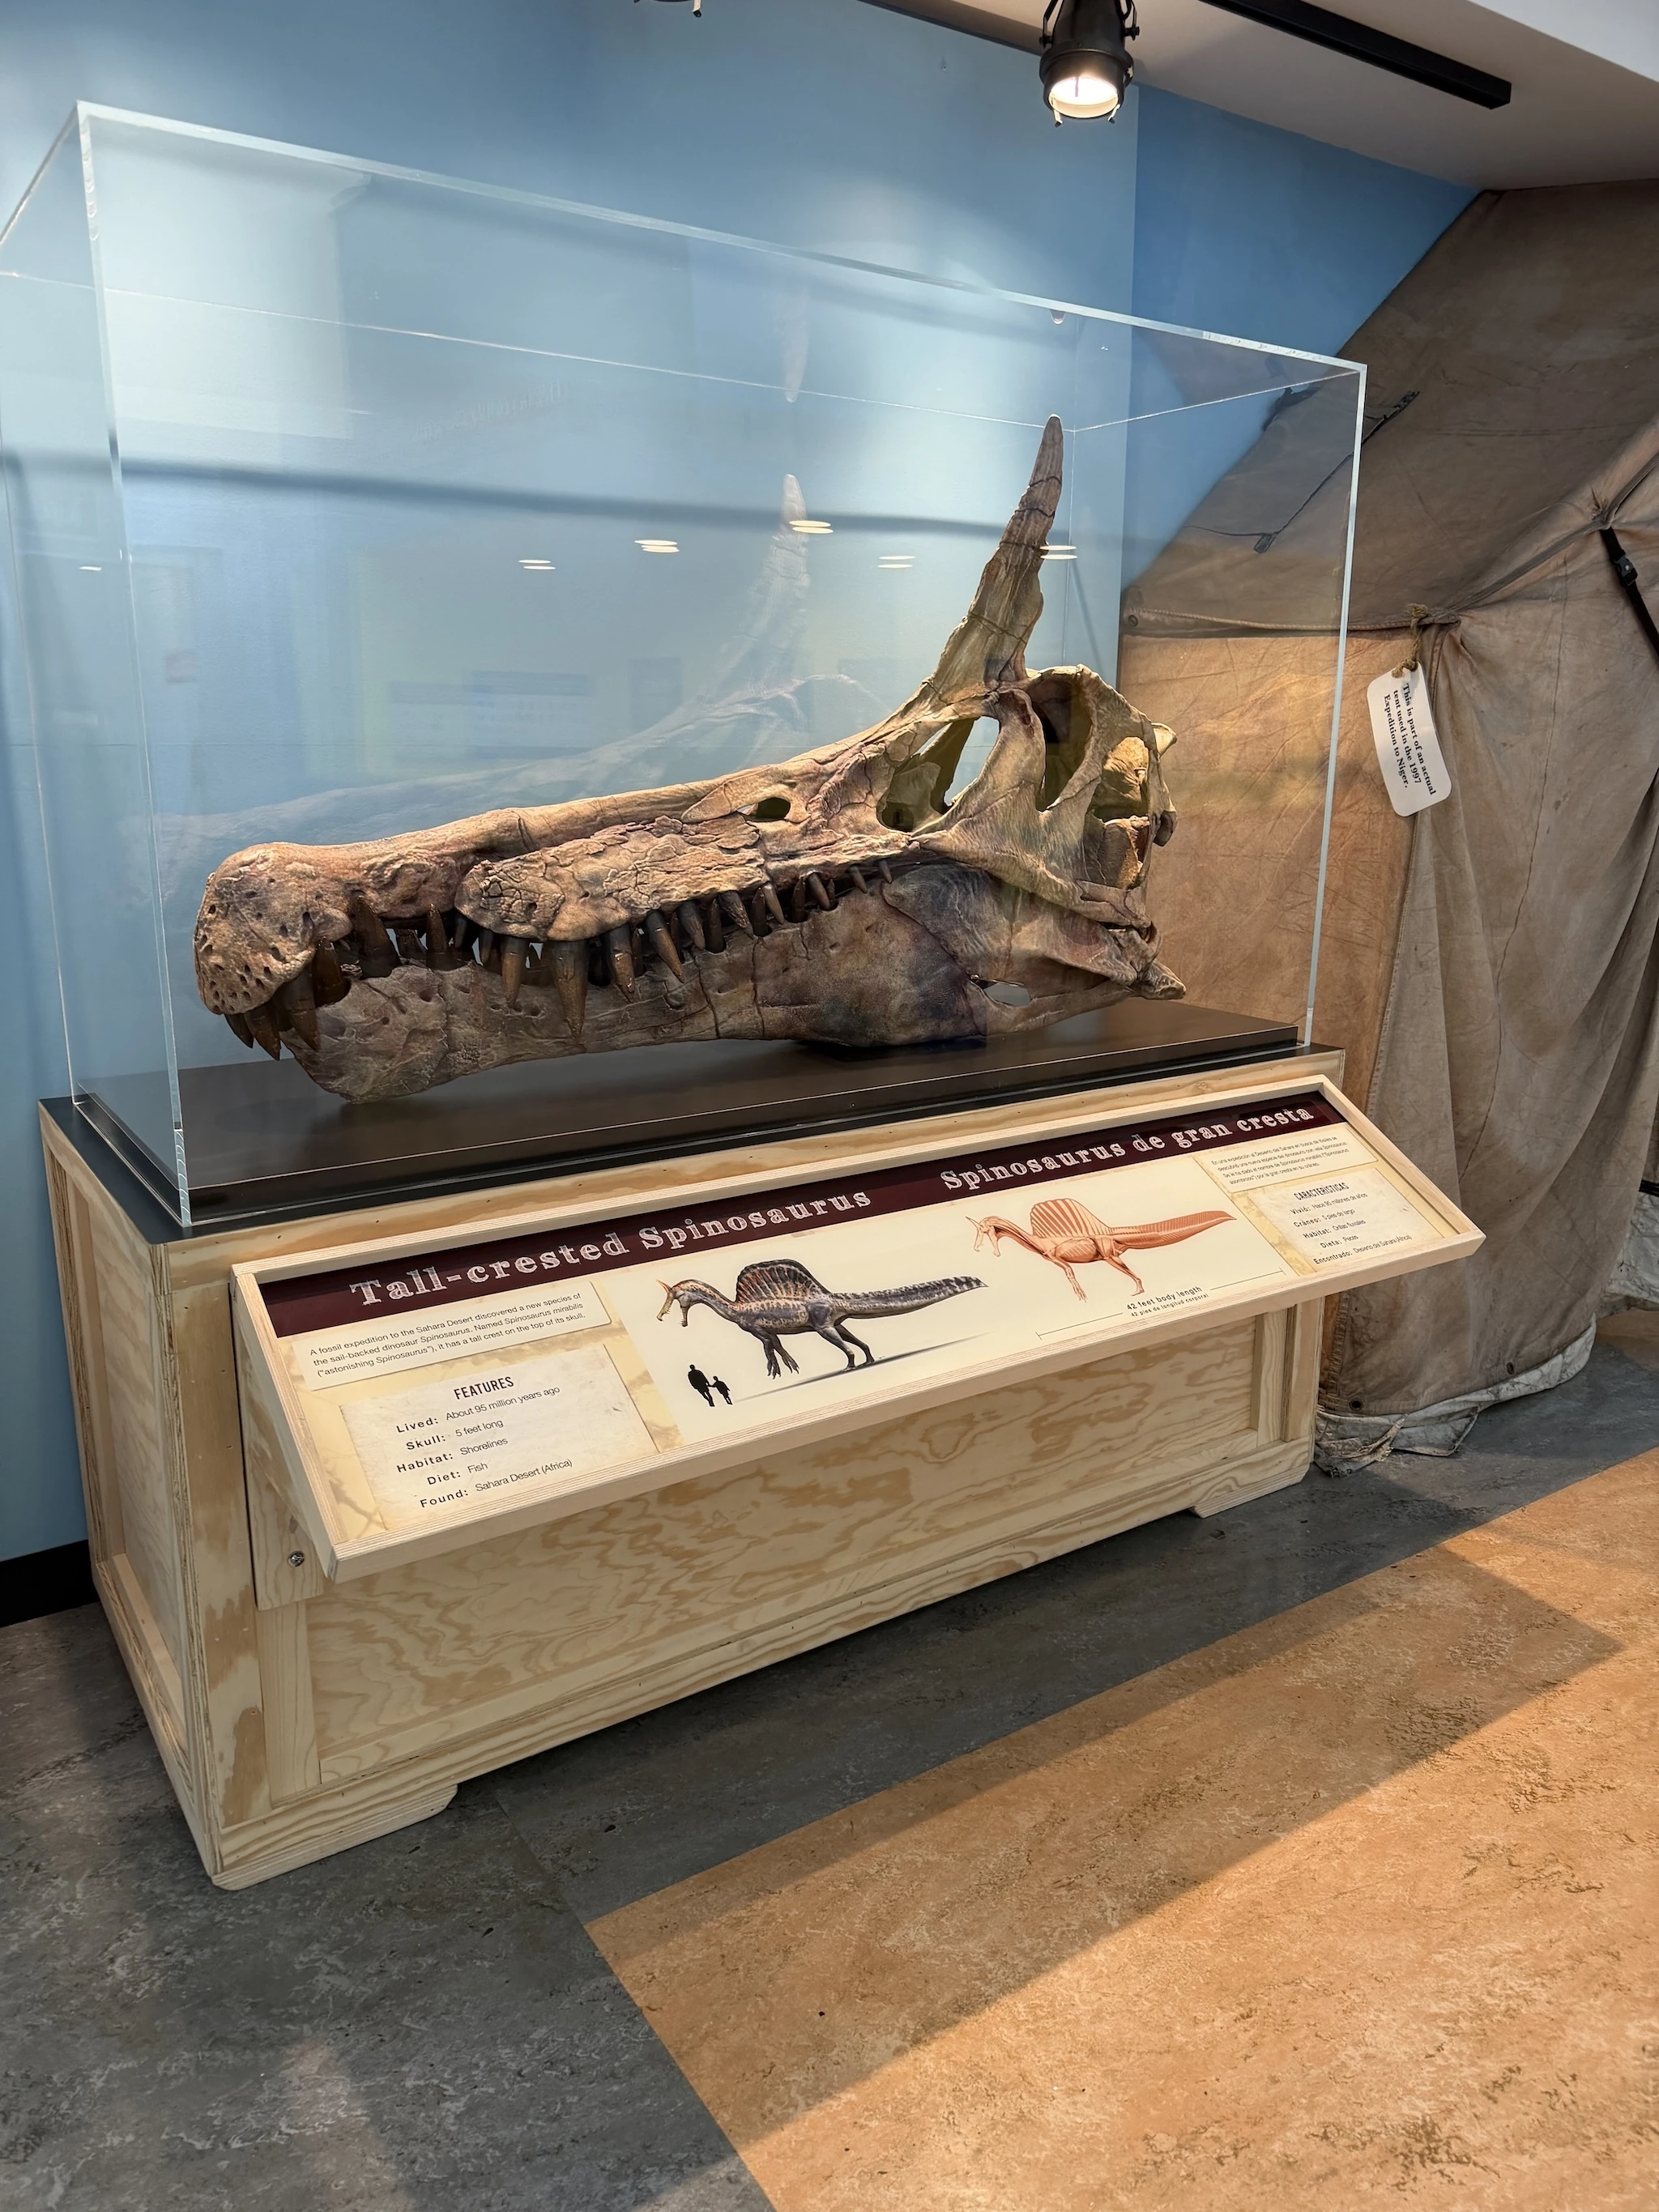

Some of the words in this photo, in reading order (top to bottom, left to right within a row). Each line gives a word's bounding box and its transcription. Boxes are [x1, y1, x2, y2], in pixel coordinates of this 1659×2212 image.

[1393, 690, 1401, 709] tent
[1402, 683, 1411, 706] This
[1397, 710, 1406, 732] used
[1406, 707, 1413, 716] is
[1401, 734, 1407, 744] in
[1408, 717, 1418, 739] part
[1384, 694, 1397, 745] Expedition
[1393, 747, 1400, 756] to
[1397, 758, 1409, 788] Niger.
[1414, 739, 1422, 751] of
[1404, 745, 1412, 761] the
[1418, 752, 1424, 764] an
[1410, 762, 1422, 783] 1997
[1421, 765, 1436, 795] actual
[940, 1141, 1126, 1191] Spinosaurus
[1132, 1133, 1165, 1152] de
[1170, 1123, 1233, 1149] gran
[1236, 1106, 1315, 1133] cresta
[1294, 1183, 1349, 1200] CARACTERÍSTICAS
[349, 1231, 629, 1306] Tall-crested
[638, 1188, 872, 1251] Spinosaurus
[1320, 1240, 1341, 1248] Dieta:
[1313, 1251, 1352, 1264] Encontrado:
[1138, 1298, 1155, 1307] feet
[1156, 1294, 1176, 1302] body
[1176, 1286, 1202, 1297] length
[318, 1344, 342, 1353] fossil
[343, 1335, 388, 1348] expedition
[416, 1323, 446, 1332] Sahara
[446, 1316, 473, 1326] Desert
[475, 1306, 518, 1320] discovered
[543, 1296, 572, 1306] species
[330, 1346, 380, 1362] sail-backed
[382, 1339, 417, 1351] dinosaur
[420, 1328, 472, 1343] Spinosaurus.
[474, 1320, 503, 1331] Named
[504, 1311, 551, 1324] Spinosaurus
[552, 1303, 582, 1314] mirabilis
[483, 1331, 503, 1339] crest
[565, 1313, 585, 1321] skull.
[454, 1376, 514, 1400] FEATURES
[396, 1417, 438, 1433] Lived:
[446, 1408, 473, 1421] About
[475, 1404, 487, 1413] 95
[488, 1396, 517, 1410] million
[518, 1391, 542, 1404] years
[544, 1387, 561, 1397] ago
[407, 1434, 446, 1450] Skull:
[463, 1423, 481, 1435] feet
[484, 1419, 503, 1430] long
[397, 1453, 453, 1473] Habitat:
[460, 1438, 508, 1455] Shorelines
[420, 1489, 468, 1507] Found:
[476, 1476, 510, 1492] Sahara
[510, 1468, 541, 1482] Desert
[541, 1459, 573, 1475] (Africa)
[427, 1471, 460, 1485] Diet:
[468, 1462, 488, 1473] Fish
